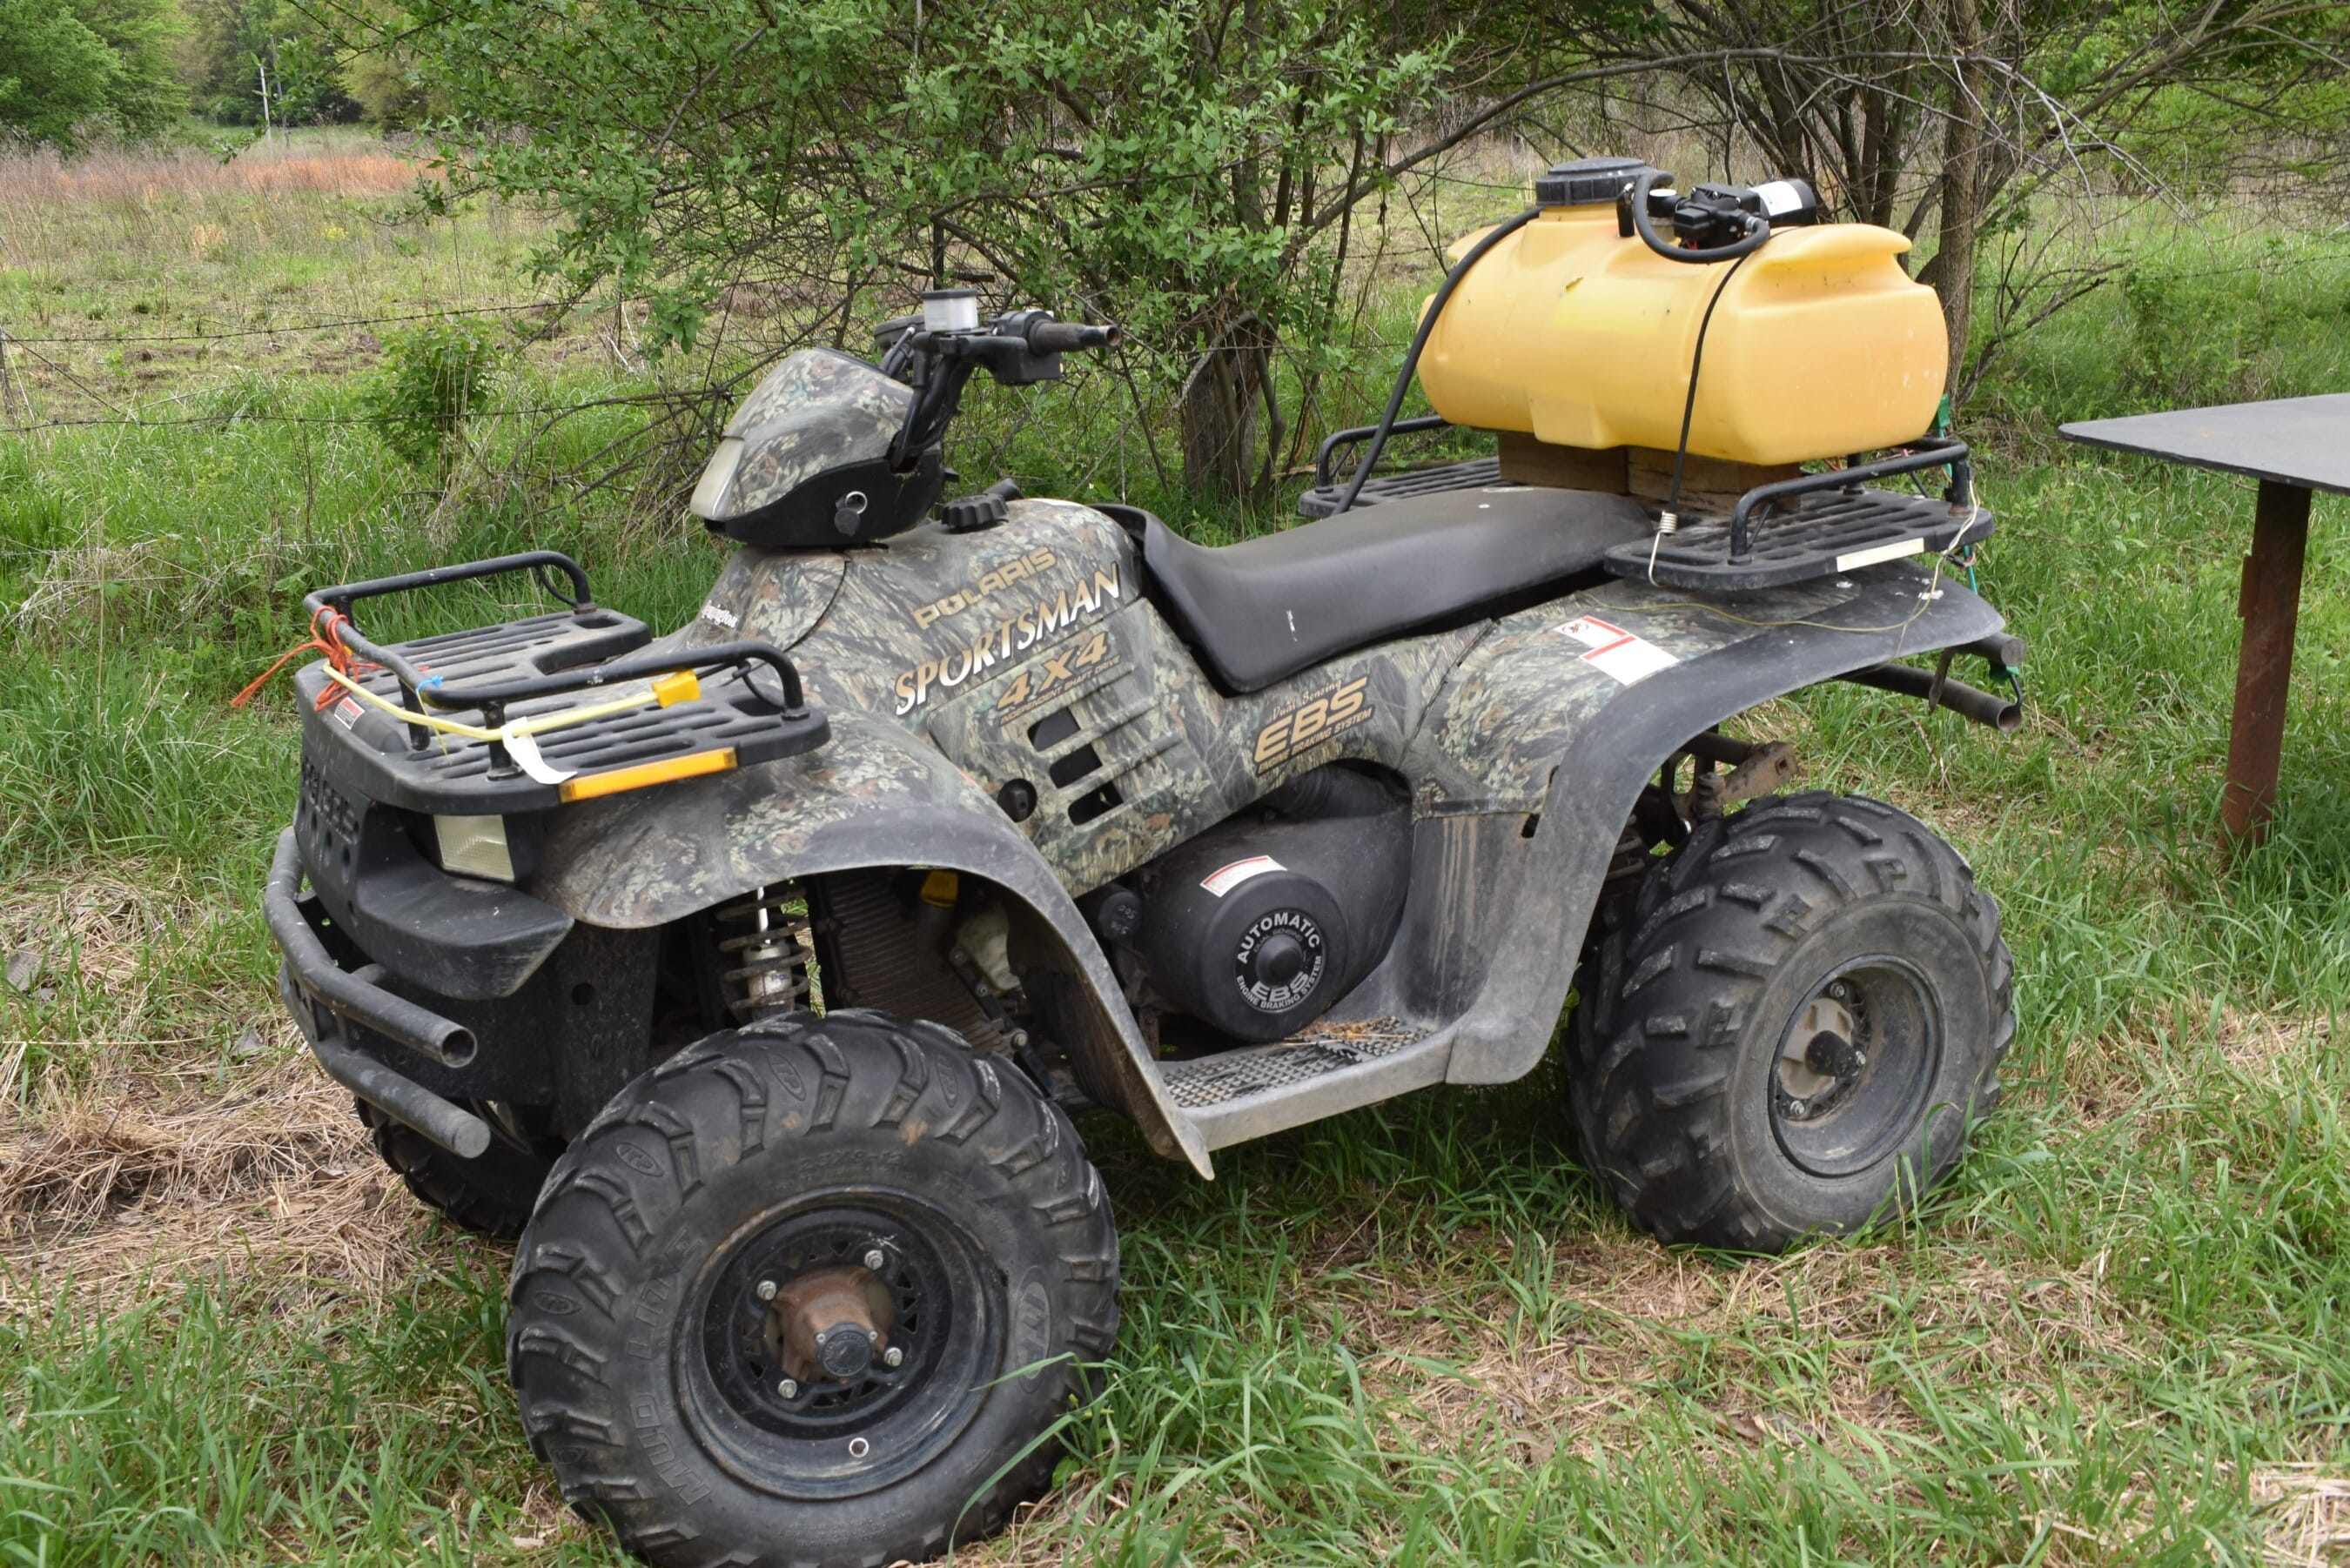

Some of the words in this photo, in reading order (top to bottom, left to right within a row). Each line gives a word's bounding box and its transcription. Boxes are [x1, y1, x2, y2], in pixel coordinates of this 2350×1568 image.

[912, 546, 1057, 630] POLARIS
[895, 560, 1120, 716] SPORTSMAN
[1002, 687, 1063, 723] INDEPENDENT
[1064, 670, 1093, 693] SHAFT
[1094, 654, 1121, 674] DRIVE
[1254, 676, 1367, 763] EBS
[1272, 697, 1296, 720] Dual
[1302, 679, 1341, 705] Sensing
[1257, 748, 1291, 774] ENGINE
[1292, 727, 1333, 756] BRAKING
[1333, 706, 1373, 734] SYSTEM
[1237, 911, 1320, 965] AUTOMATIC
[1236, 975, 1259, 1006] ENGINE
[1259, 992, 1301, 1010] BRAKING
[1300, 955, 1322, 995] SYSTEM
[1251, 971, 1309, 1002] EBS
[628, 1393, 712, 1507] MUD
